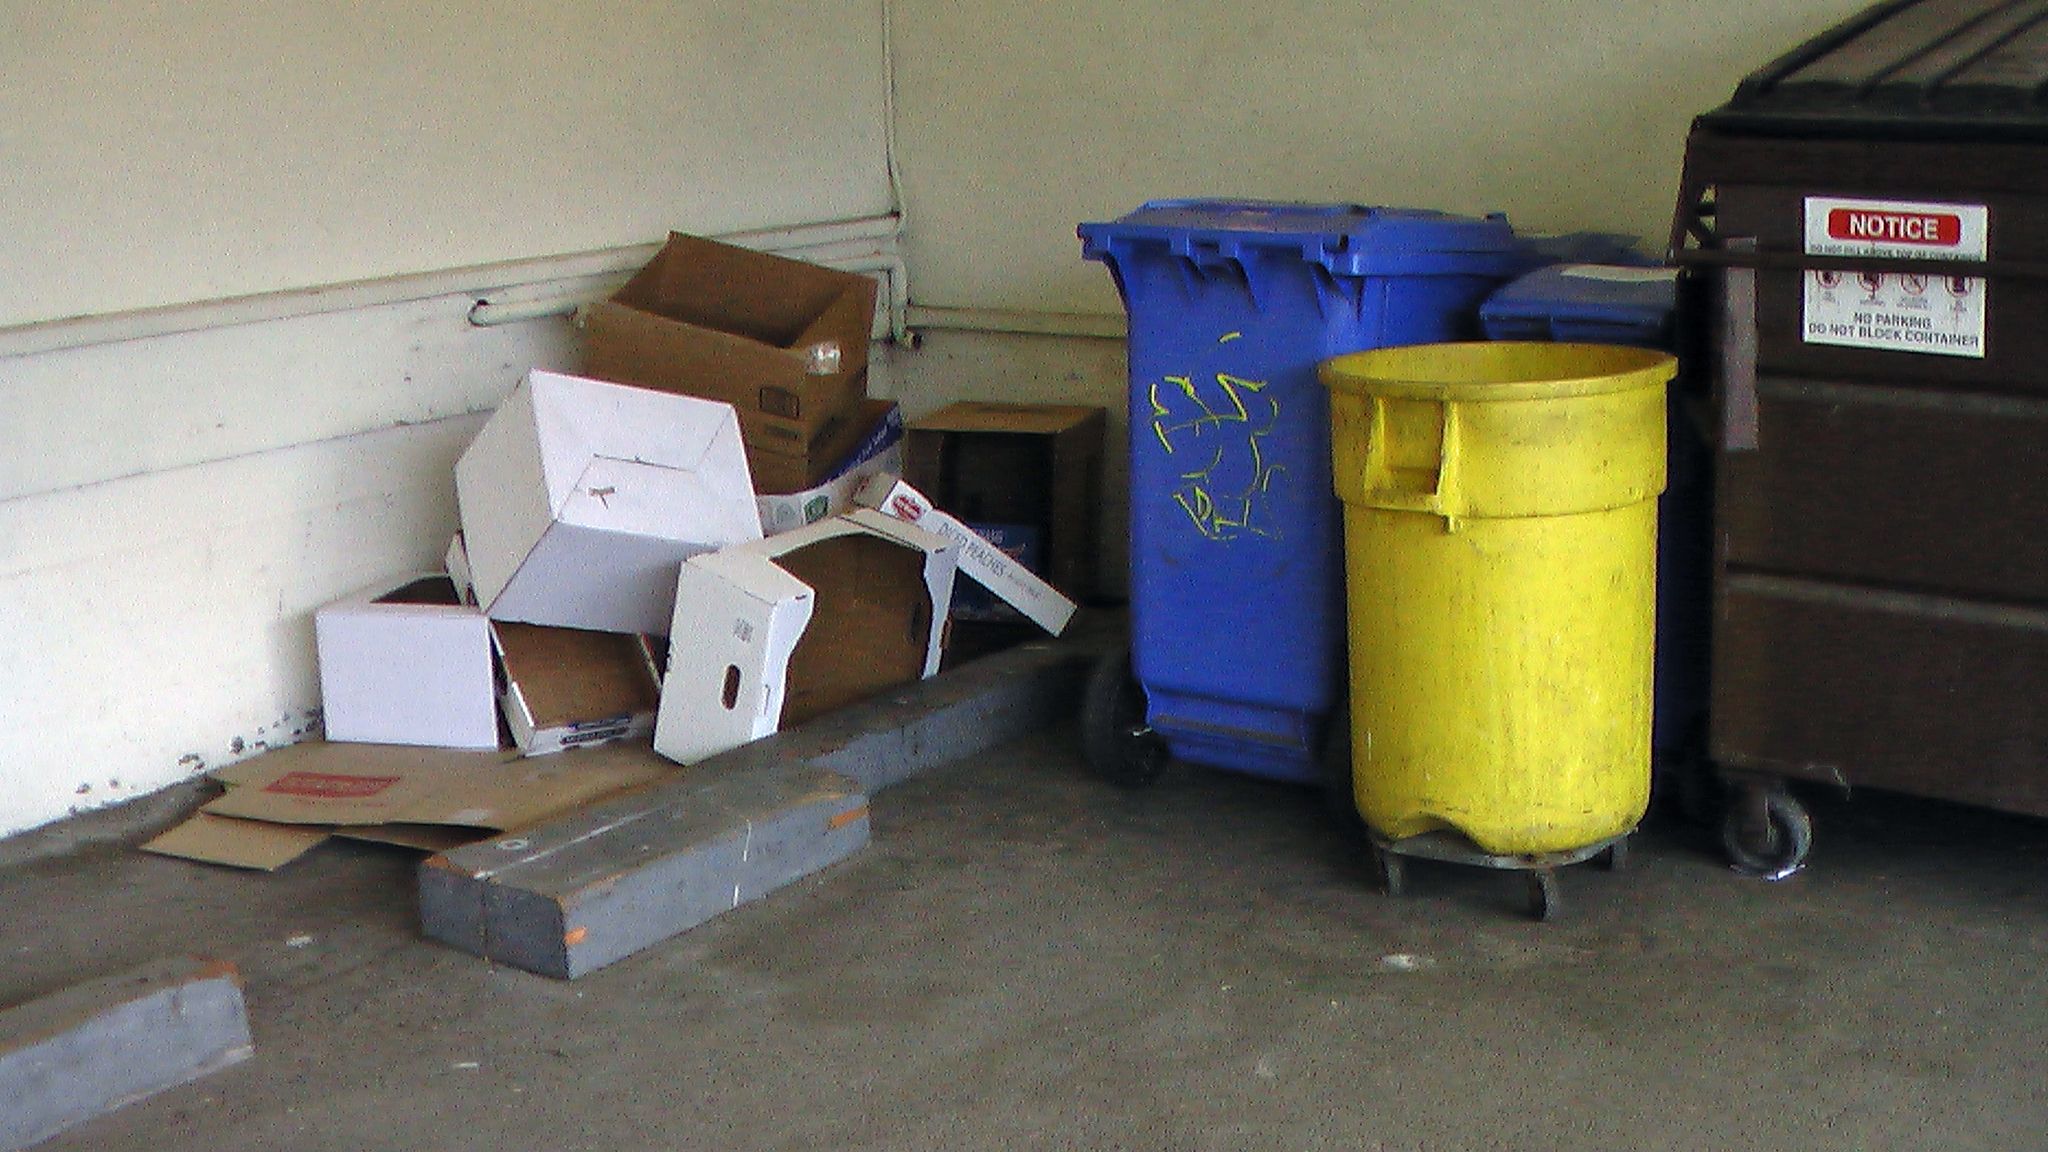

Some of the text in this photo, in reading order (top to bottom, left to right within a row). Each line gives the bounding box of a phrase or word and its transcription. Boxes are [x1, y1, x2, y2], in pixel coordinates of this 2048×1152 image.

[1849, 212, 1940, 241] NOTICE
[1811, 243, 1823, 254] DO
[1854, 311, 1932, 330] NO PARKING
[1808, 322, 1979, 349] DO NOT BLOCK CONTAINER
[963, 542, 1007, 578] PEACHES
